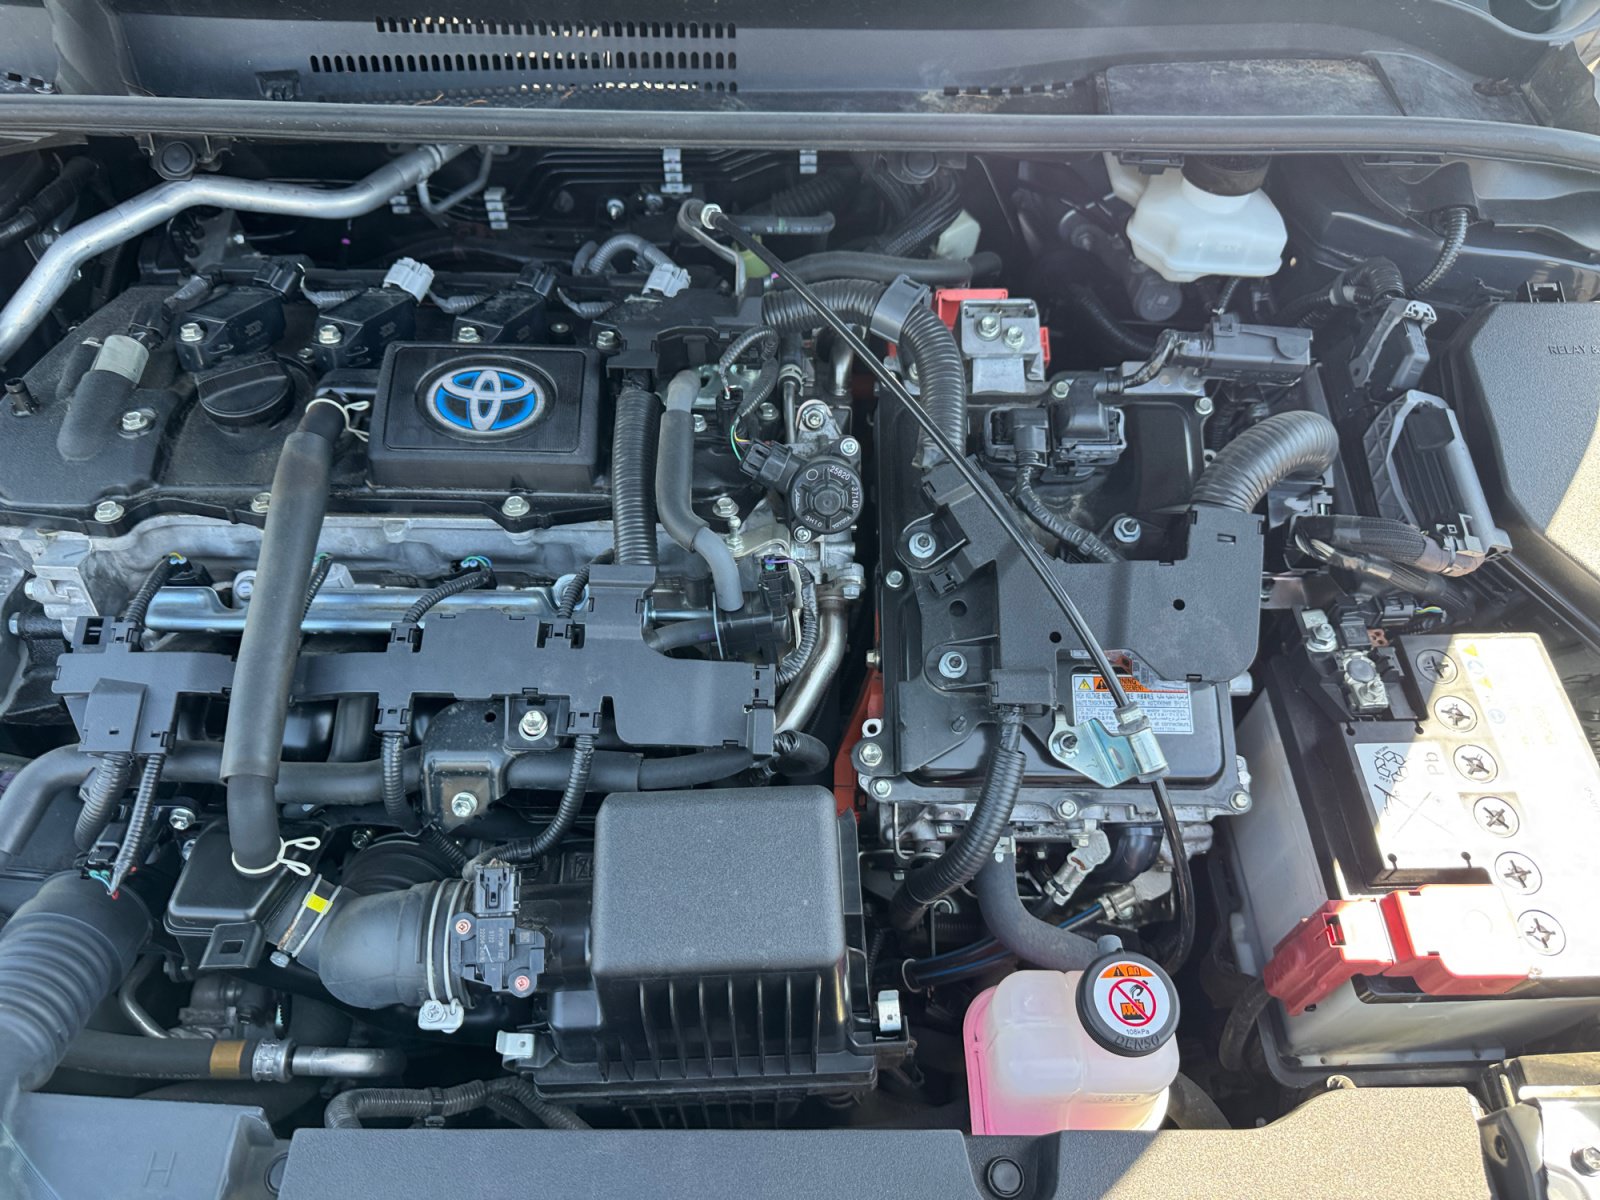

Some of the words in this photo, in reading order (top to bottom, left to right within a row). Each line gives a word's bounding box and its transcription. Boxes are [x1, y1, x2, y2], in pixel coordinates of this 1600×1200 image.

[1548, 345, 1585, 355] RELAY
[1424, 751, 1444, 776] Pb
[1114, 1034, 1160, 1049] DENSO
